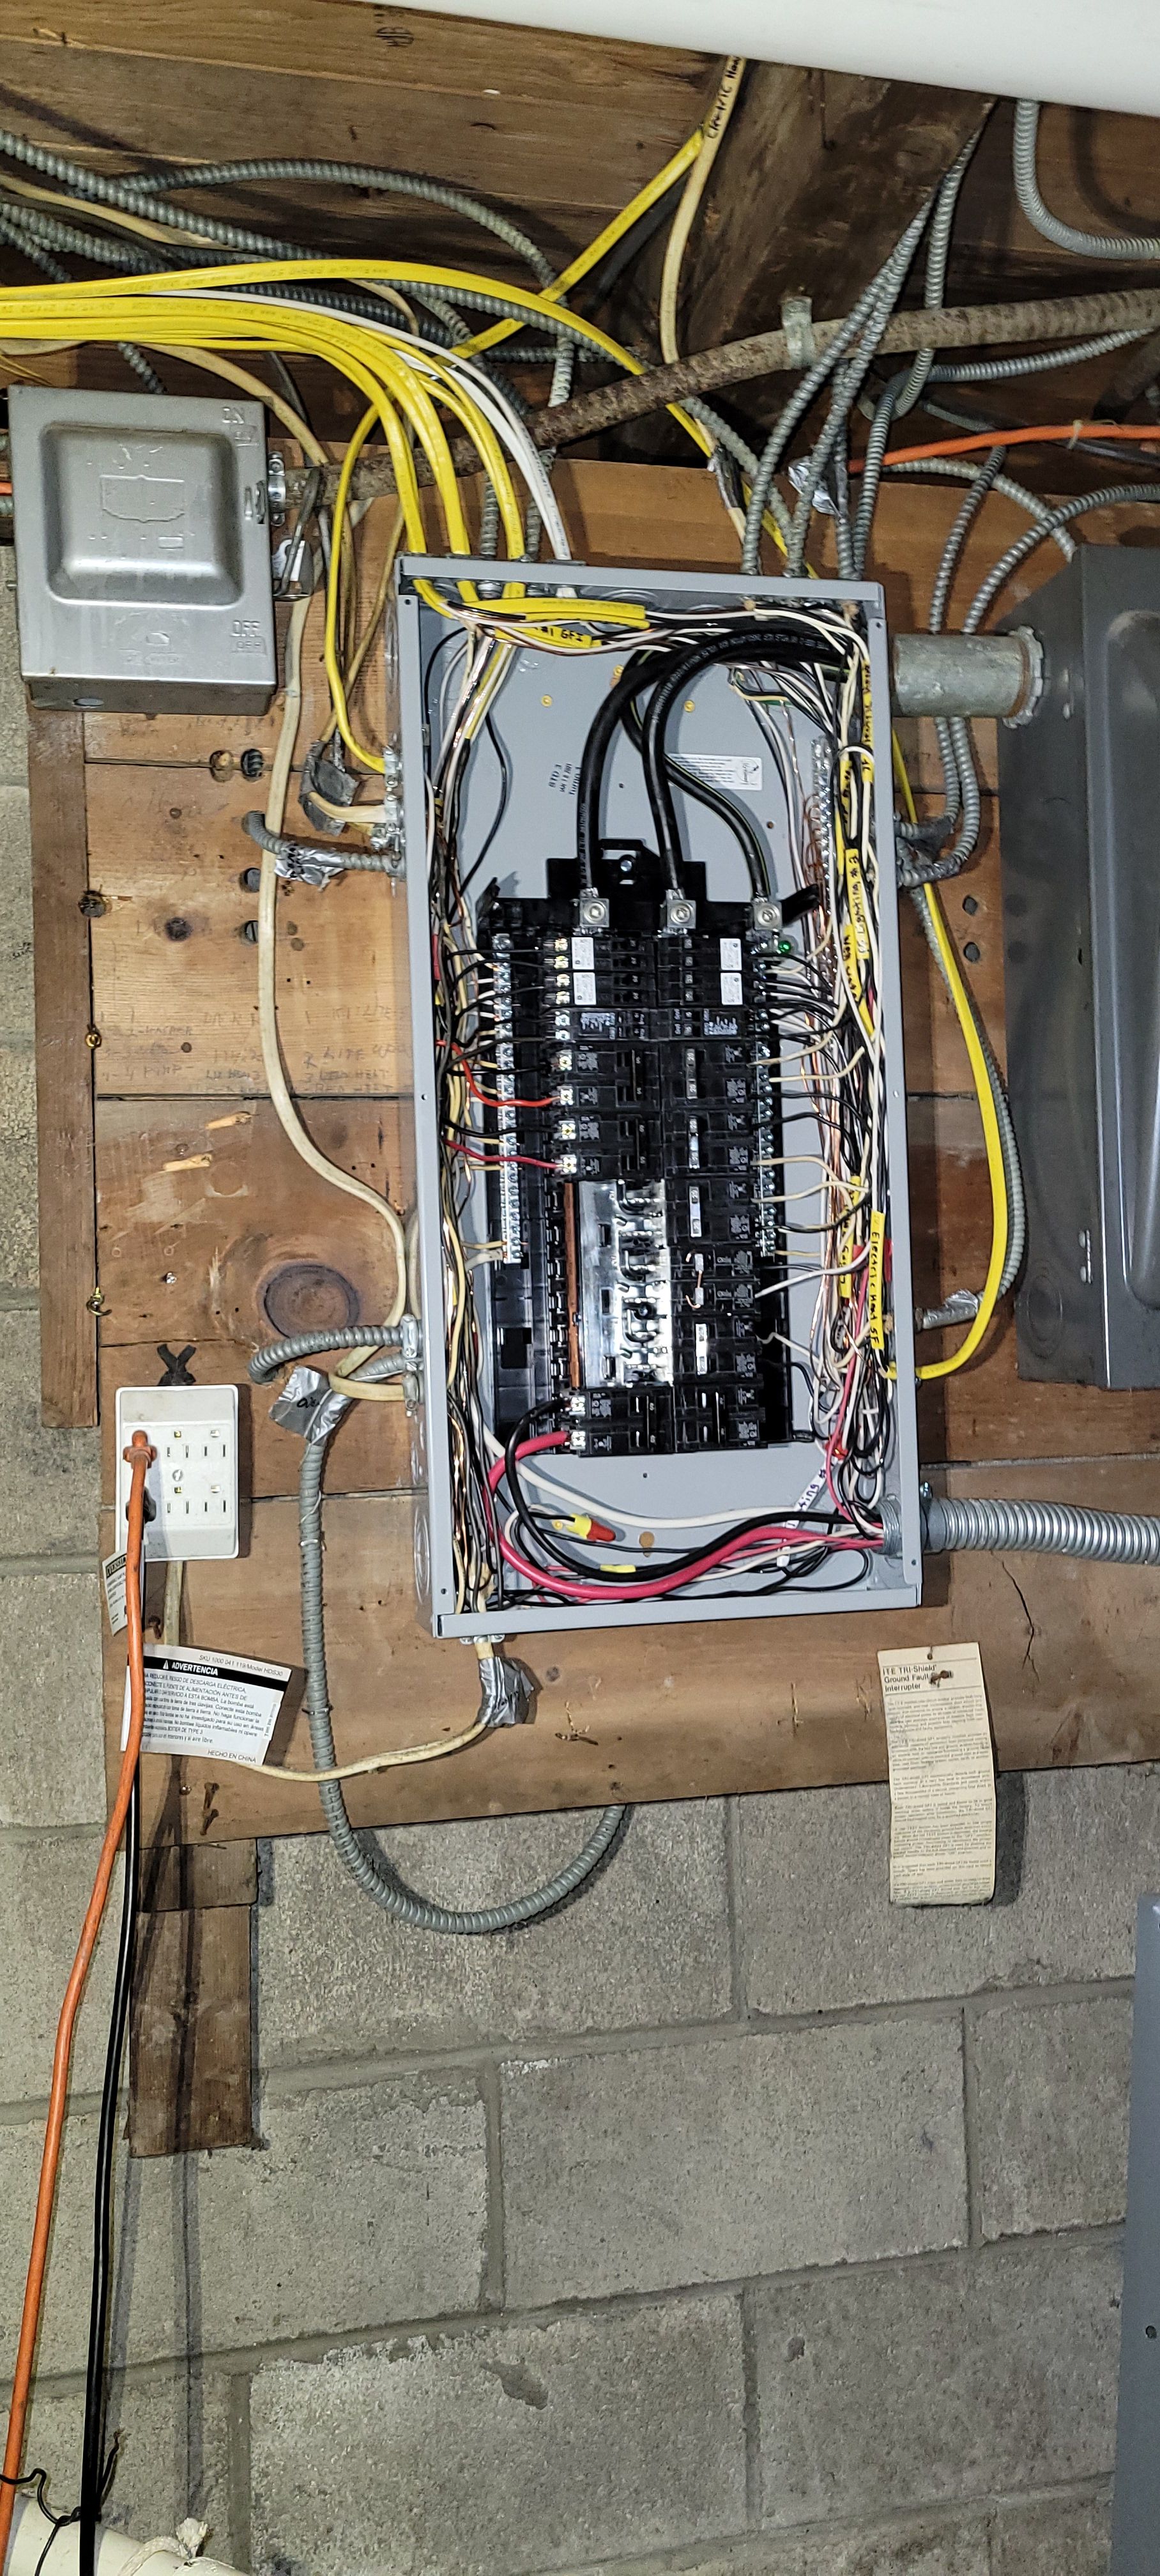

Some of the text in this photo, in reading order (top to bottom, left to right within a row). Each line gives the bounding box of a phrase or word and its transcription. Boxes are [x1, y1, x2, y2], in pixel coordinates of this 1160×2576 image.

[231, 619, 261, 638] OFF
[870, 1231, 881, 1289] Electric
[171, 1661, 219, 1676] ADVERTENCIA
[190, 1678, 217, 1689] DESCARGA
[883, 1675, 910, 1684] Ground
[884, 1683, 921, 1692] Interrupter
[222, 1691, 238, 1700] ANTES
[208, 1749, 257, 1763] HECHO EN CHINA
